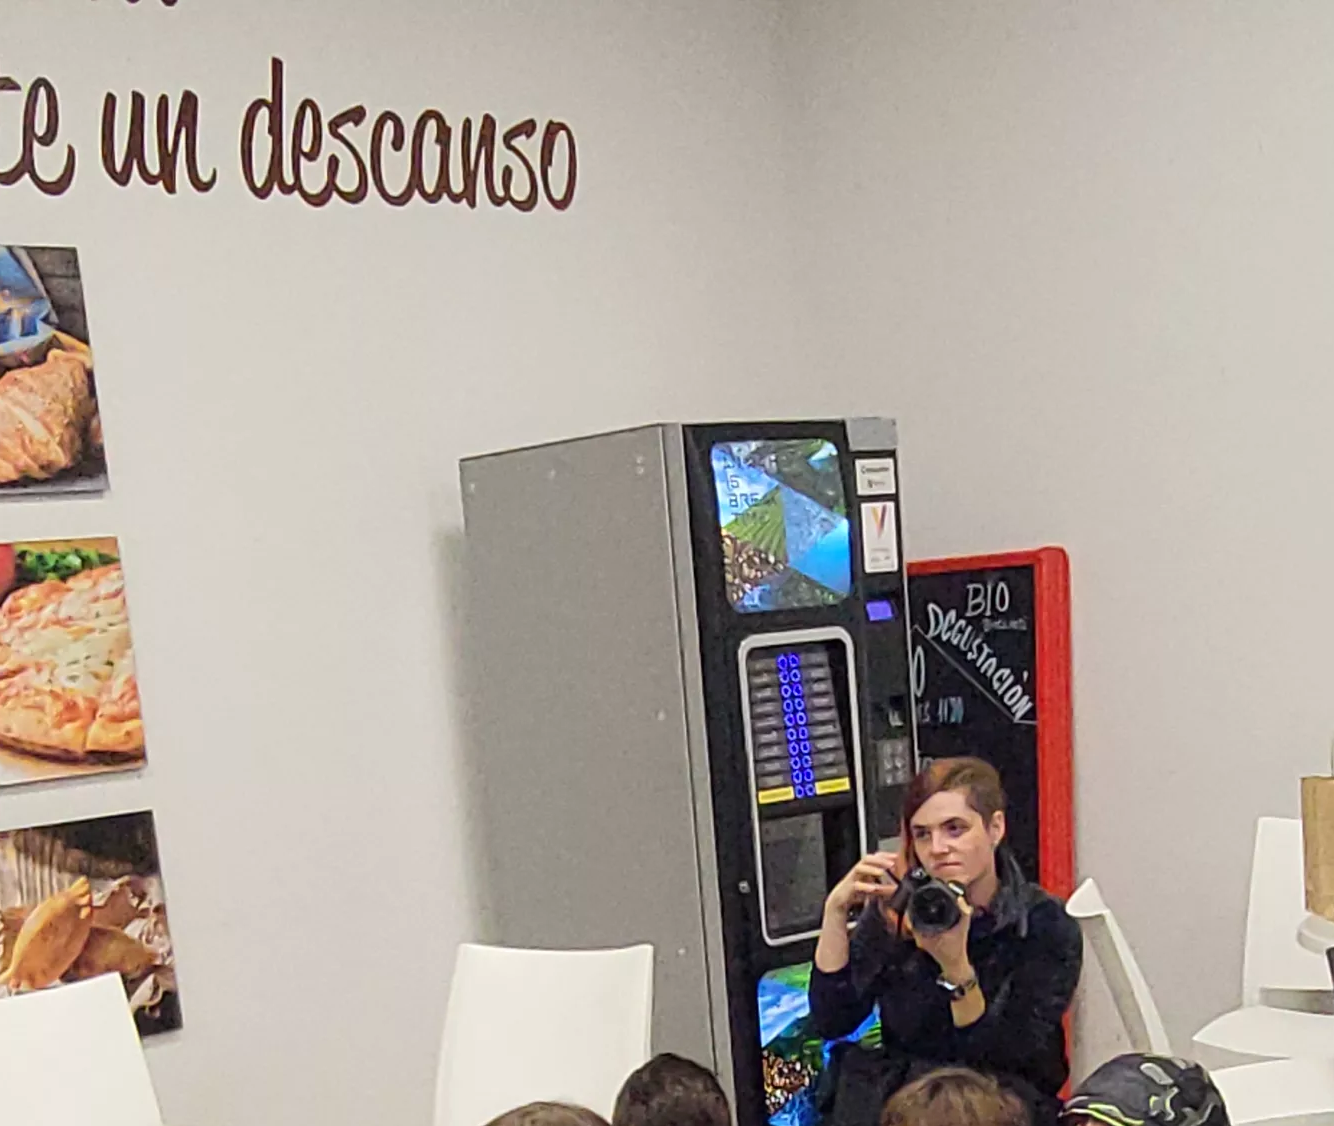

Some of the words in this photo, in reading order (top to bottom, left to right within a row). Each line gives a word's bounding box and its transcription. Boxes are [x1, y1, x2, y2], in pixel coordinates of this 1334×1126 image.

[101, 88, 216, 195] un
[241, 57, 578, 212] descanso
[965, 581, 1011, 617] BIO
